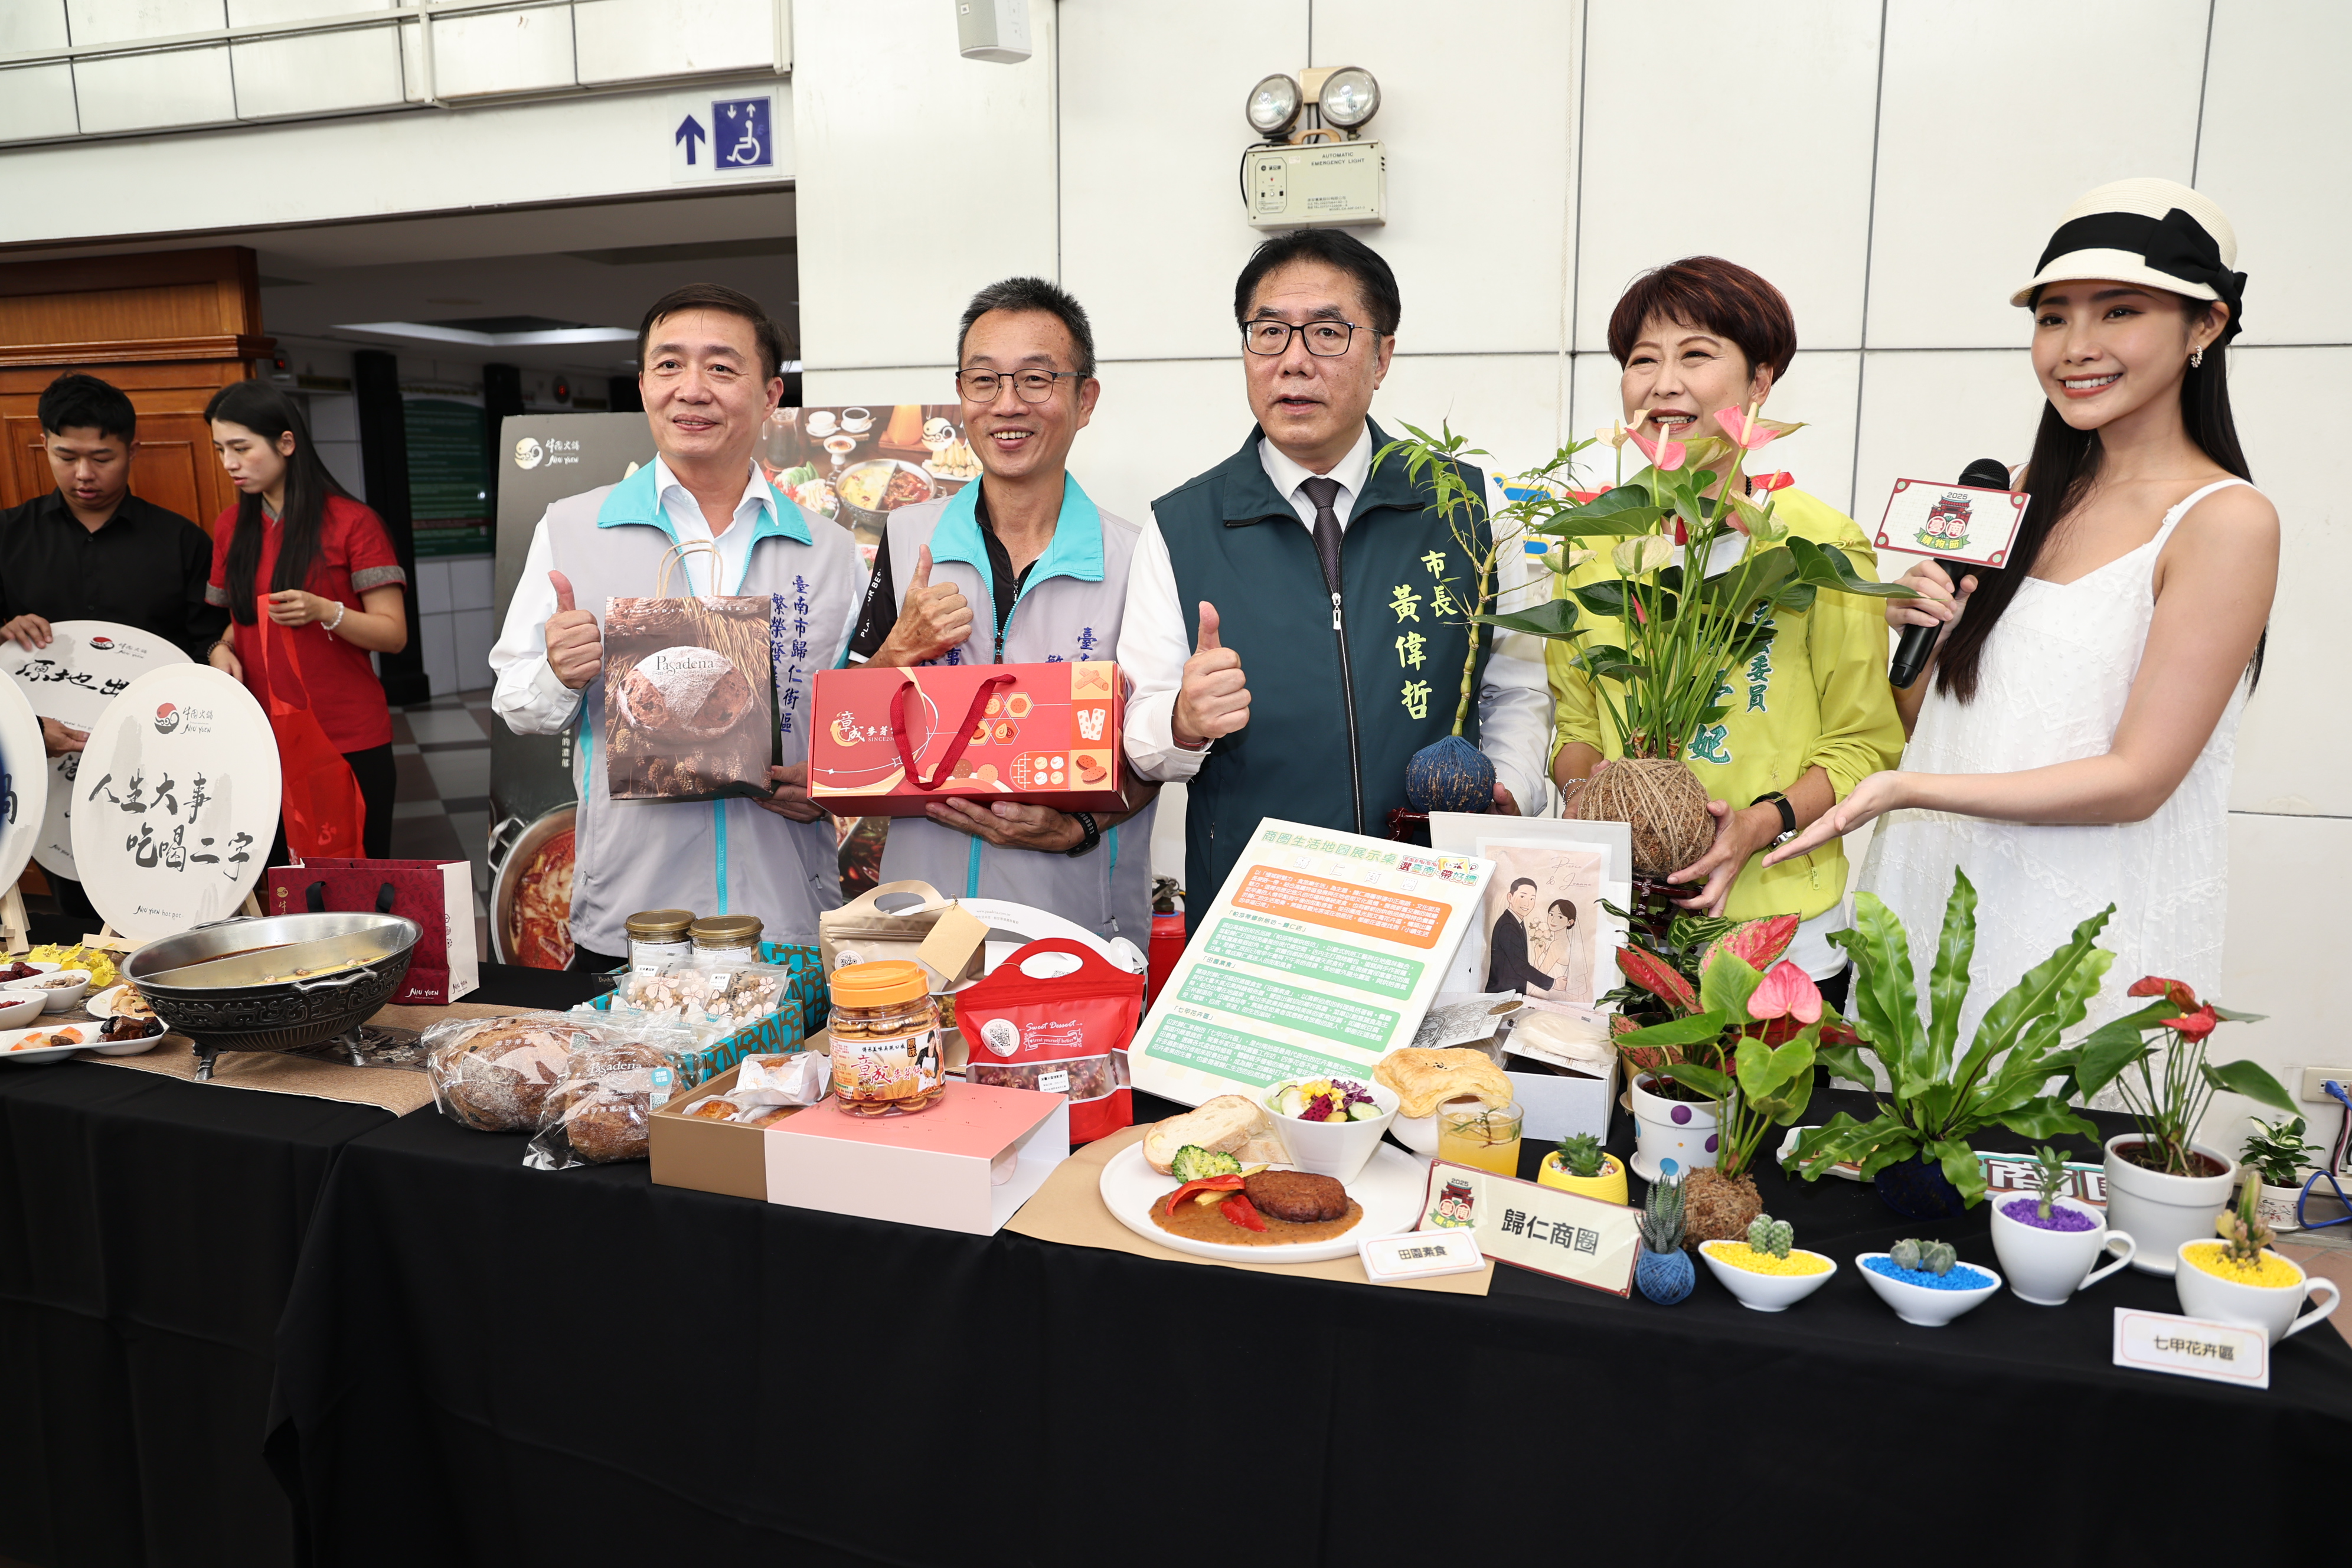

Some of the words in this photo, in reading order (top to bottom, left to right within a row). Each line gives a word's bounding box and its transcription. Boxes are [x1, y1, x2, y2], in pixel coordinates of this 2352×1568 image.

[544, 455, 563, 467] NIU
[564, 456, 579, 465] YUEN
[1946, 492, 1968, 500] 2025
[1928, 519, 1964, 535] 臺南
[1920, 534, 1960, 549] 購物節
[1420, 550, 1458, 618] 市長
[780, 575, 809, 733] 臺南市歸仁街區
[1389, 584, 1432, 720] 黃偉哲
[656, 655, 714, 676] Pasadena
[179, 723, 197, 734] NIU
[834, 711, 865, 742] 章成
[866, 726, 894, 736] 麥芽
[89, 768, 212, 824] 人生大事
[126, 822, 253, 882] 吃喝二字
[1261, 829, 1397, 864] 商圈生活地圖展示桌
[1403, 856, 1438, 866] TAINAN
[1292, 855, 1419, 891] 歸仁商圈
[1546, 876, 1555, 886] &
[133, 905, 148, 915] NIU
[404, 988, 423, 997] NIU
[1026, 1023, 1048, 1031] Sweet
[1049, 1020, 1077, 1029] Dessert
[907, 1038, 916, 1057] 原味
[590, 1061, 642, 1076] Pasadena
[851, 1054, 893, 1084] 章成
[1451, 1178, 1469, 1187] 2025
[1440, 1200, 1469, 1219] 臺南
[1501, 1208, 1599, 1256] 歸仁商圈
[1398, 1245, 1448, 1260] 田園素食
[2153, 1335, 2235, 1360] 七甲花卉區
